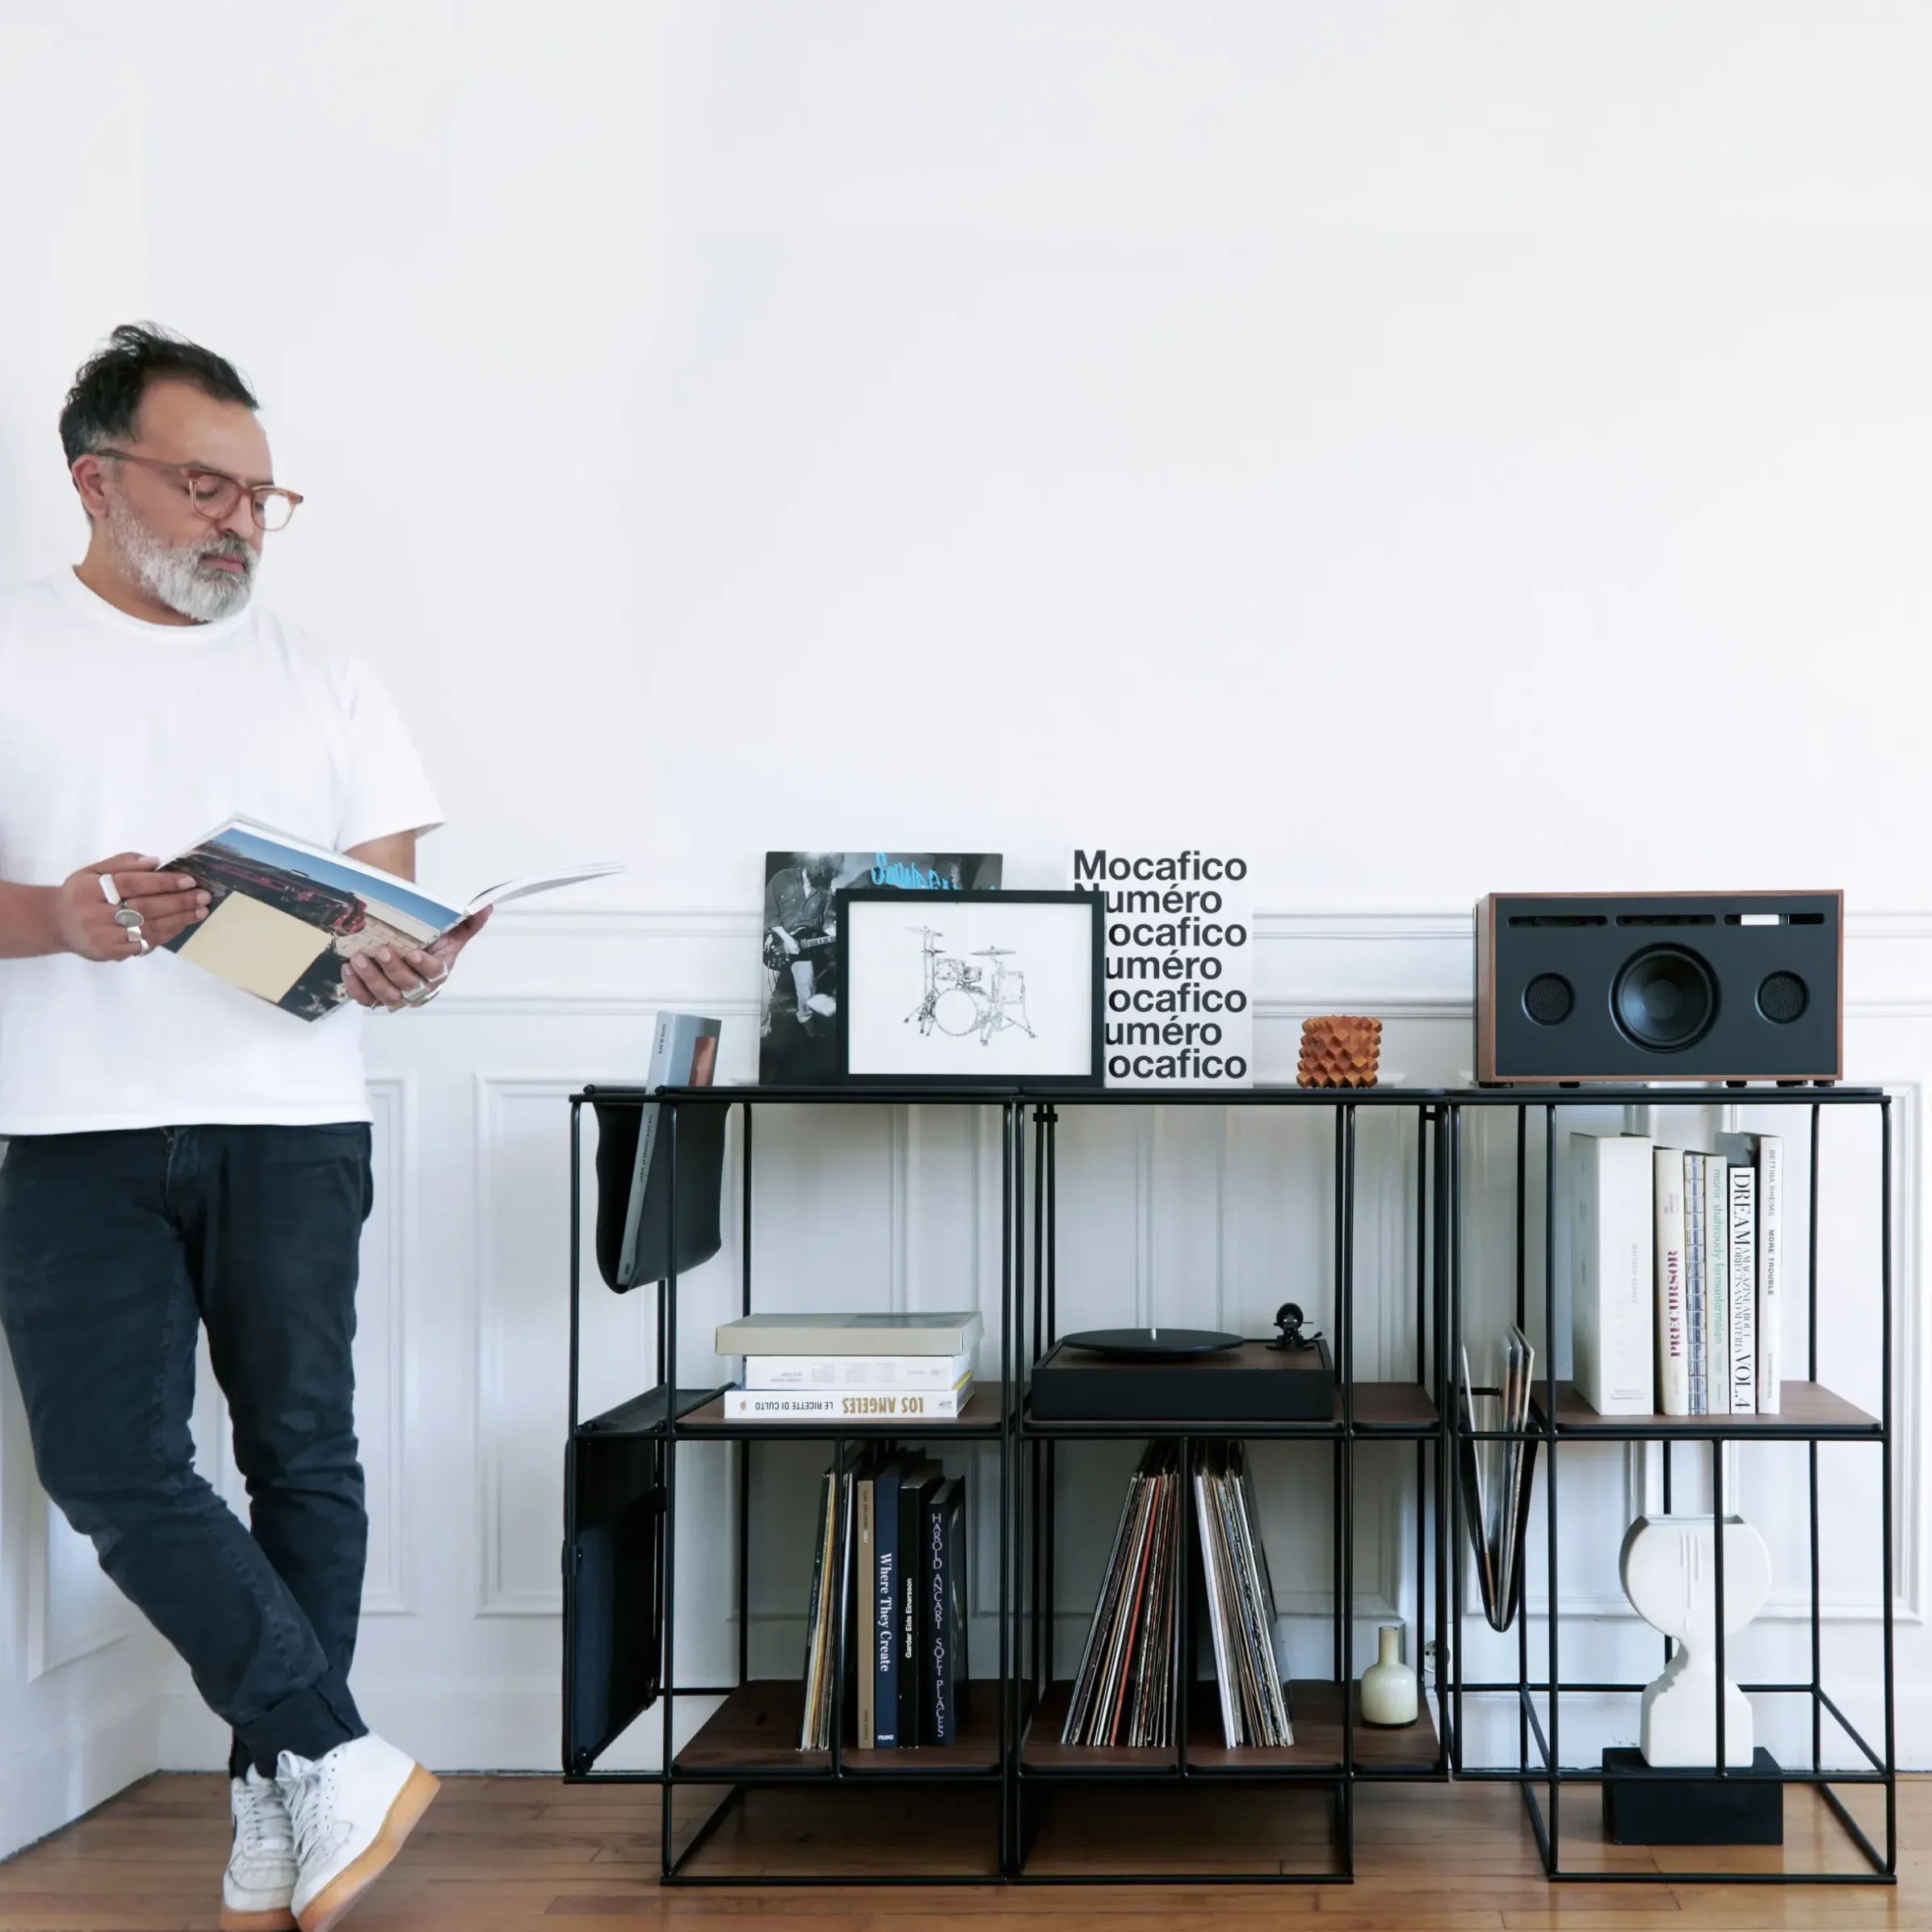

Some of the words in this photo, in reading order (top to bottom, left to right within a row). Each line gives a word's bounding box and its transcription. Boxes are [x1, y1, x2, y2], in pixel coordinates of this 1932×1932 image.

[1074, 850, 1247, 880] Mocafico
[1074, 883, 1222, 914] uméro
[1108, 917, 1247, 947] ocafico
[1105, 949, 1222, 980] uméro
[1108, 982, 1247, 1013] ocafico
[1105, 1015, 1222, 1045] uméro
[1108, 1048, 1247, 1078] ocafico
[1713, 1169, 1722, 1199] monir
[1734, 1173, 1751, 1246] DREAM
[1712, 1204, 1726, 1259] shahroudy
[1733, 1247, 1742, 1287] OBJECTS
[1742, 1254, 1751, 1305] MAGAZINE
[1767, 1257, 1775, 1296] TROUBLE
[1667, 1250, 1681, 1357] PRECURSOR
[1713, 1263, 1725, 1344] farmanfarmaian
[1734, 1287, 1742, 1309] AND
[1742, 1306, 1751, 1338] ABOUT
[1734, 1354, 1751, 1409] VOL.4
[754, 1401, 779, 1410] CULTO
[781, 1401, 790, 1410] DI
[792, 1401, 822, 1410] RICETTE
[824, 1401, 834, 1410] LE
[842, 1396, 897, 1414] ANGELES
[901, 1396, 924, 1413] LOS
[931, 1514, 943, 1570] HAROLD
[880, 1552, 892, 1594] Where
[905, 1577, 913, 1614] Einarsson
[933, 1573, 943, 1630] ANCART
[877, 1597, 892, 1628] They
[905, 1615, 913, 1632] Eide
[880, 1631, 892, 1672] Create
[905, 1633, 913, 1658] Gardar
[934, 1637, 944, 1676] SOFT
[935, 1679, 944, 1737] PLACES
